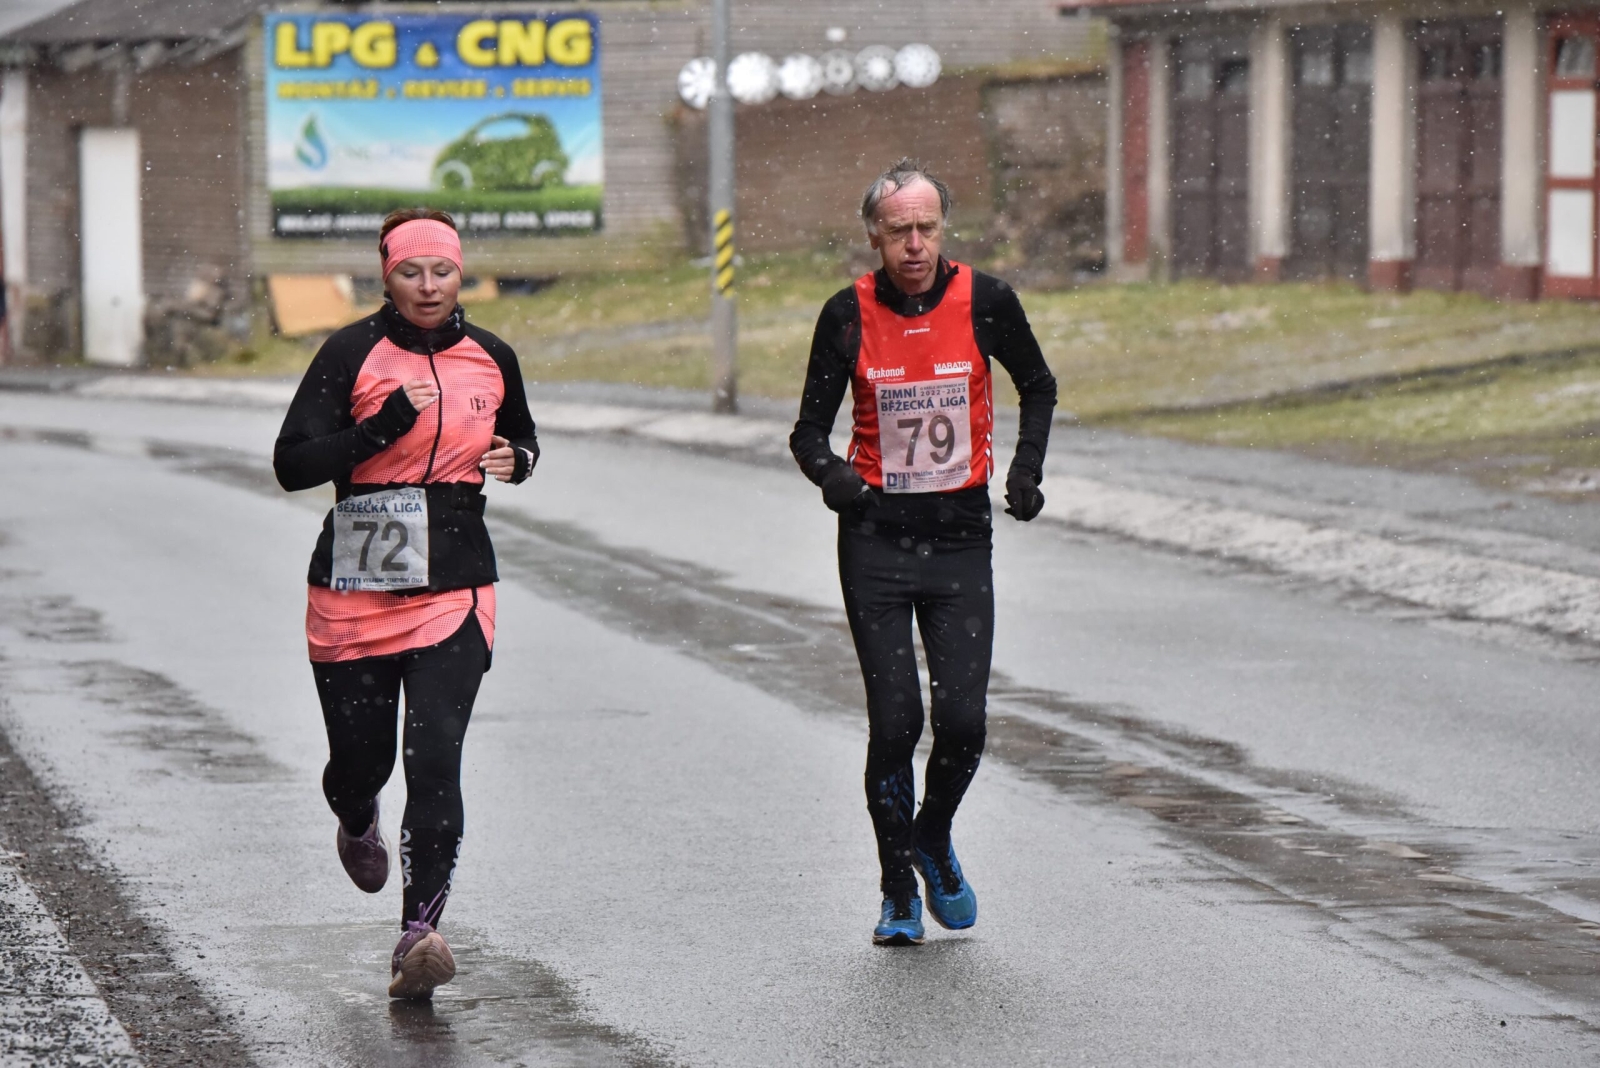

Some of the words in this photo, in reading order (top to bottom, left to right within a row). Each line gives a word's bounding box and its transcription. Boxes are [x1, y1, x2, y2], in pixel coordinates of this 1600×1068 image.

[275, 21, 397, 68] LPG
[457, 18, 592, 67] CNG
[880, 386, 917, 399] ZIMNÍ
[881, 397, 934, 411] BĚŽECKÁ
[940, 396, 966, 408] LIGA
[897, 415, 955, 466] 79
[394, 503, 422, 513] LIGA
[353, 521, 408, 571] 72
